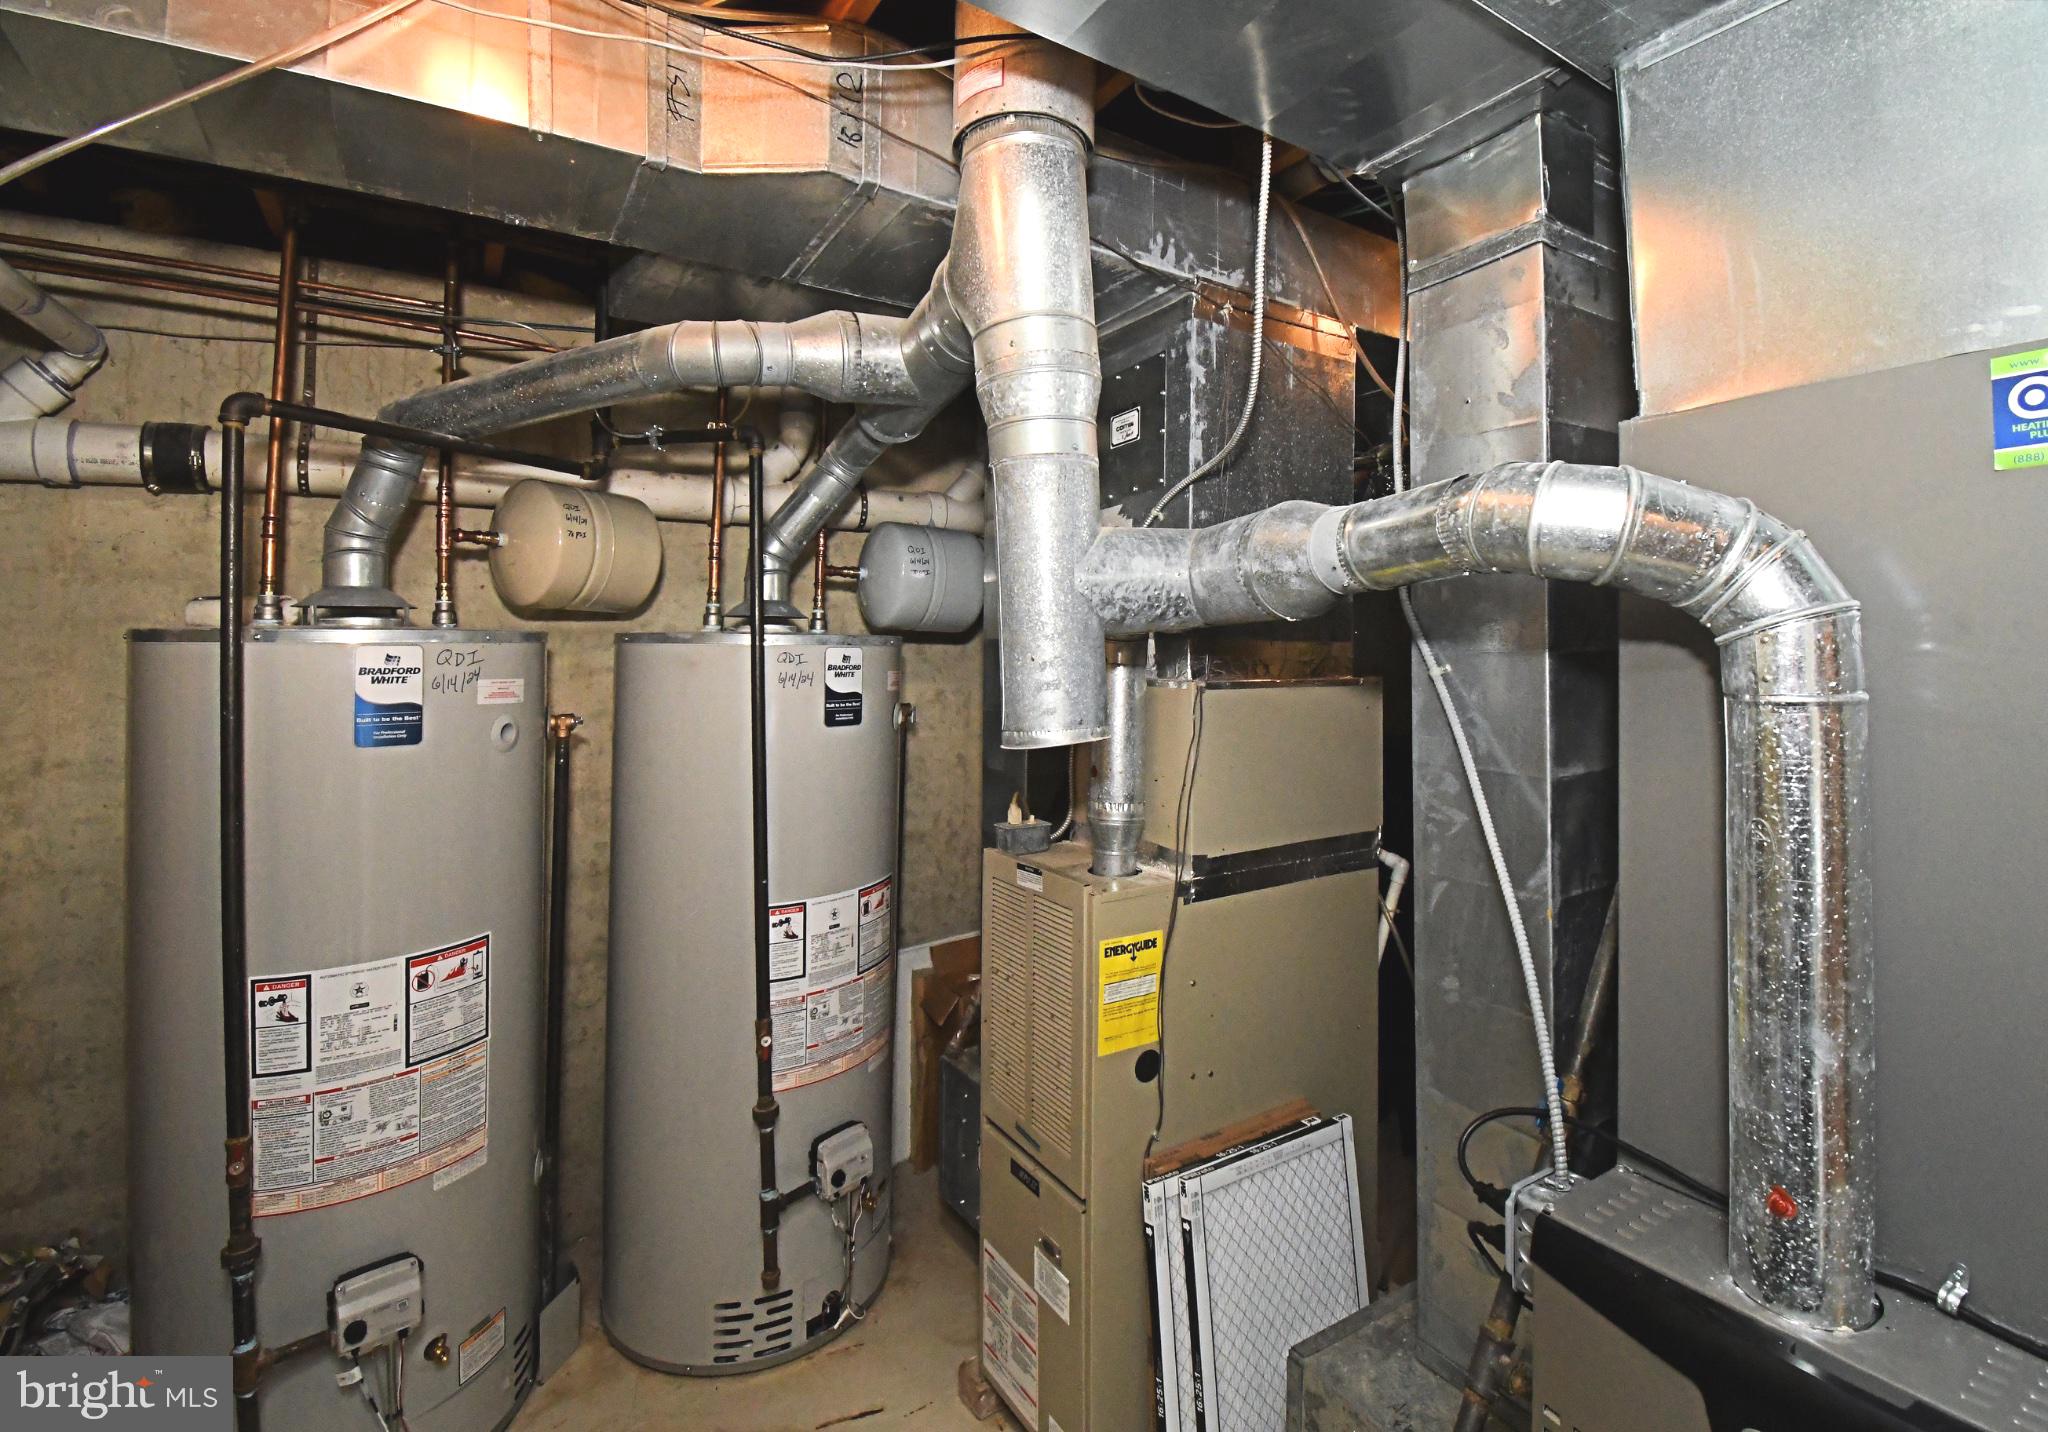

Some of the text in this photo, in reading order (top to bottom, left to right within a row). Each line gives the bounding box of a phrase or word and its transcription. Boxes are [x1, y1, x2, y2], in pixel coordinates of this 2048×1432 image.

[2009, 358, 2040, 369] www
[2013, 452, 2045, 464] (888)
[437, 648, 485, 667] QDI
[777, 652, 808, 666] QDI
[358, 667, 421, 676] BRADFORD
[371, 676, 409, 684] WHITE
[431, 666, 481, 694] 6/14/24
[778, 671, 815, 689] 6/14/24
